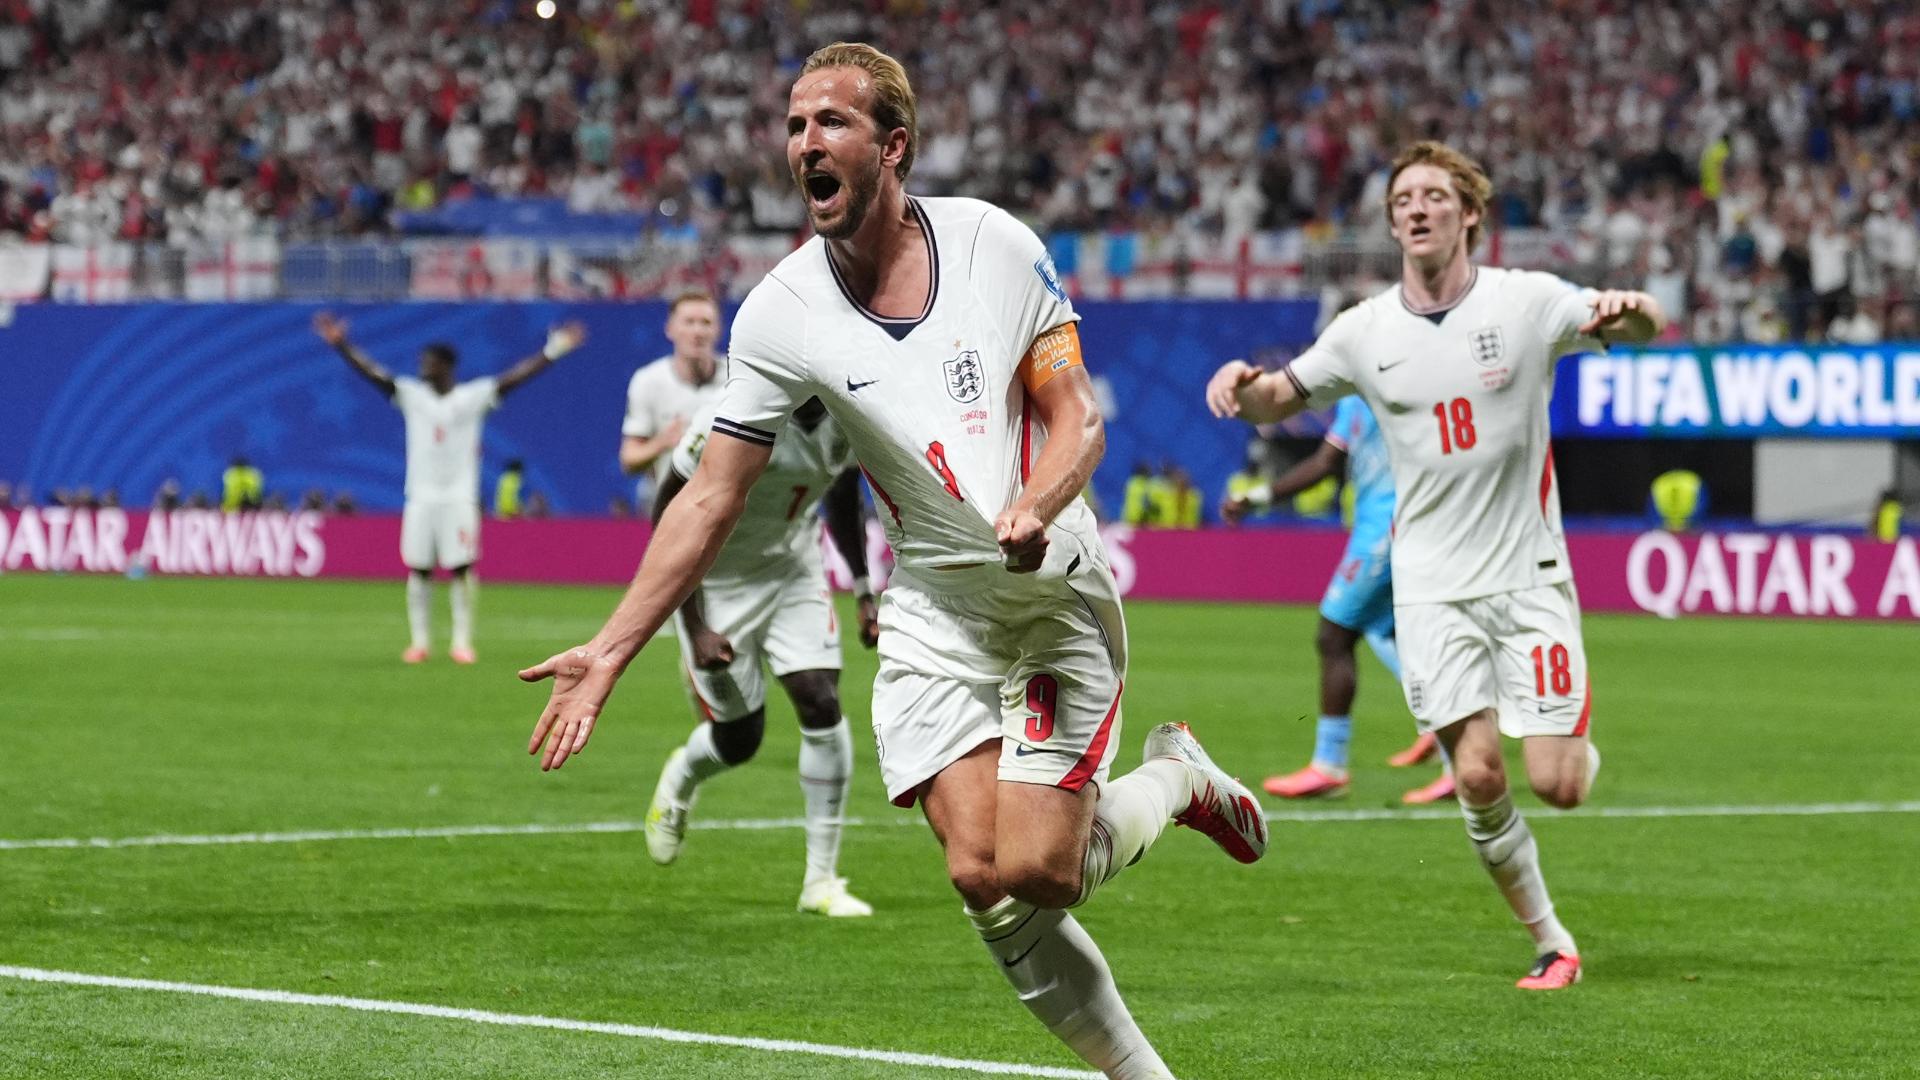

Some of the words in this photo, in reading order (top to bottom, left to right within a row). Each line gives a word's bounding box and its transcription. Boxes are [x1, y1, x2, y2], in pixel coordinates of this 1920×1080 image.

[1031, 331, 1070, 359] UNITES
[1052, 359, 1068, 370] FIFA
[1578, 352, 1710, 427] FIFA
[1433, 396, 1477, 455] 18
[786, 484, 808, 521] 7
[140, 506, 326, 577] AIRWAYS
[1626, 530, 1857, 619] QATAR
[1531, 642, 1573, 697] 18
[1024, 673, 1058, 742] 9
